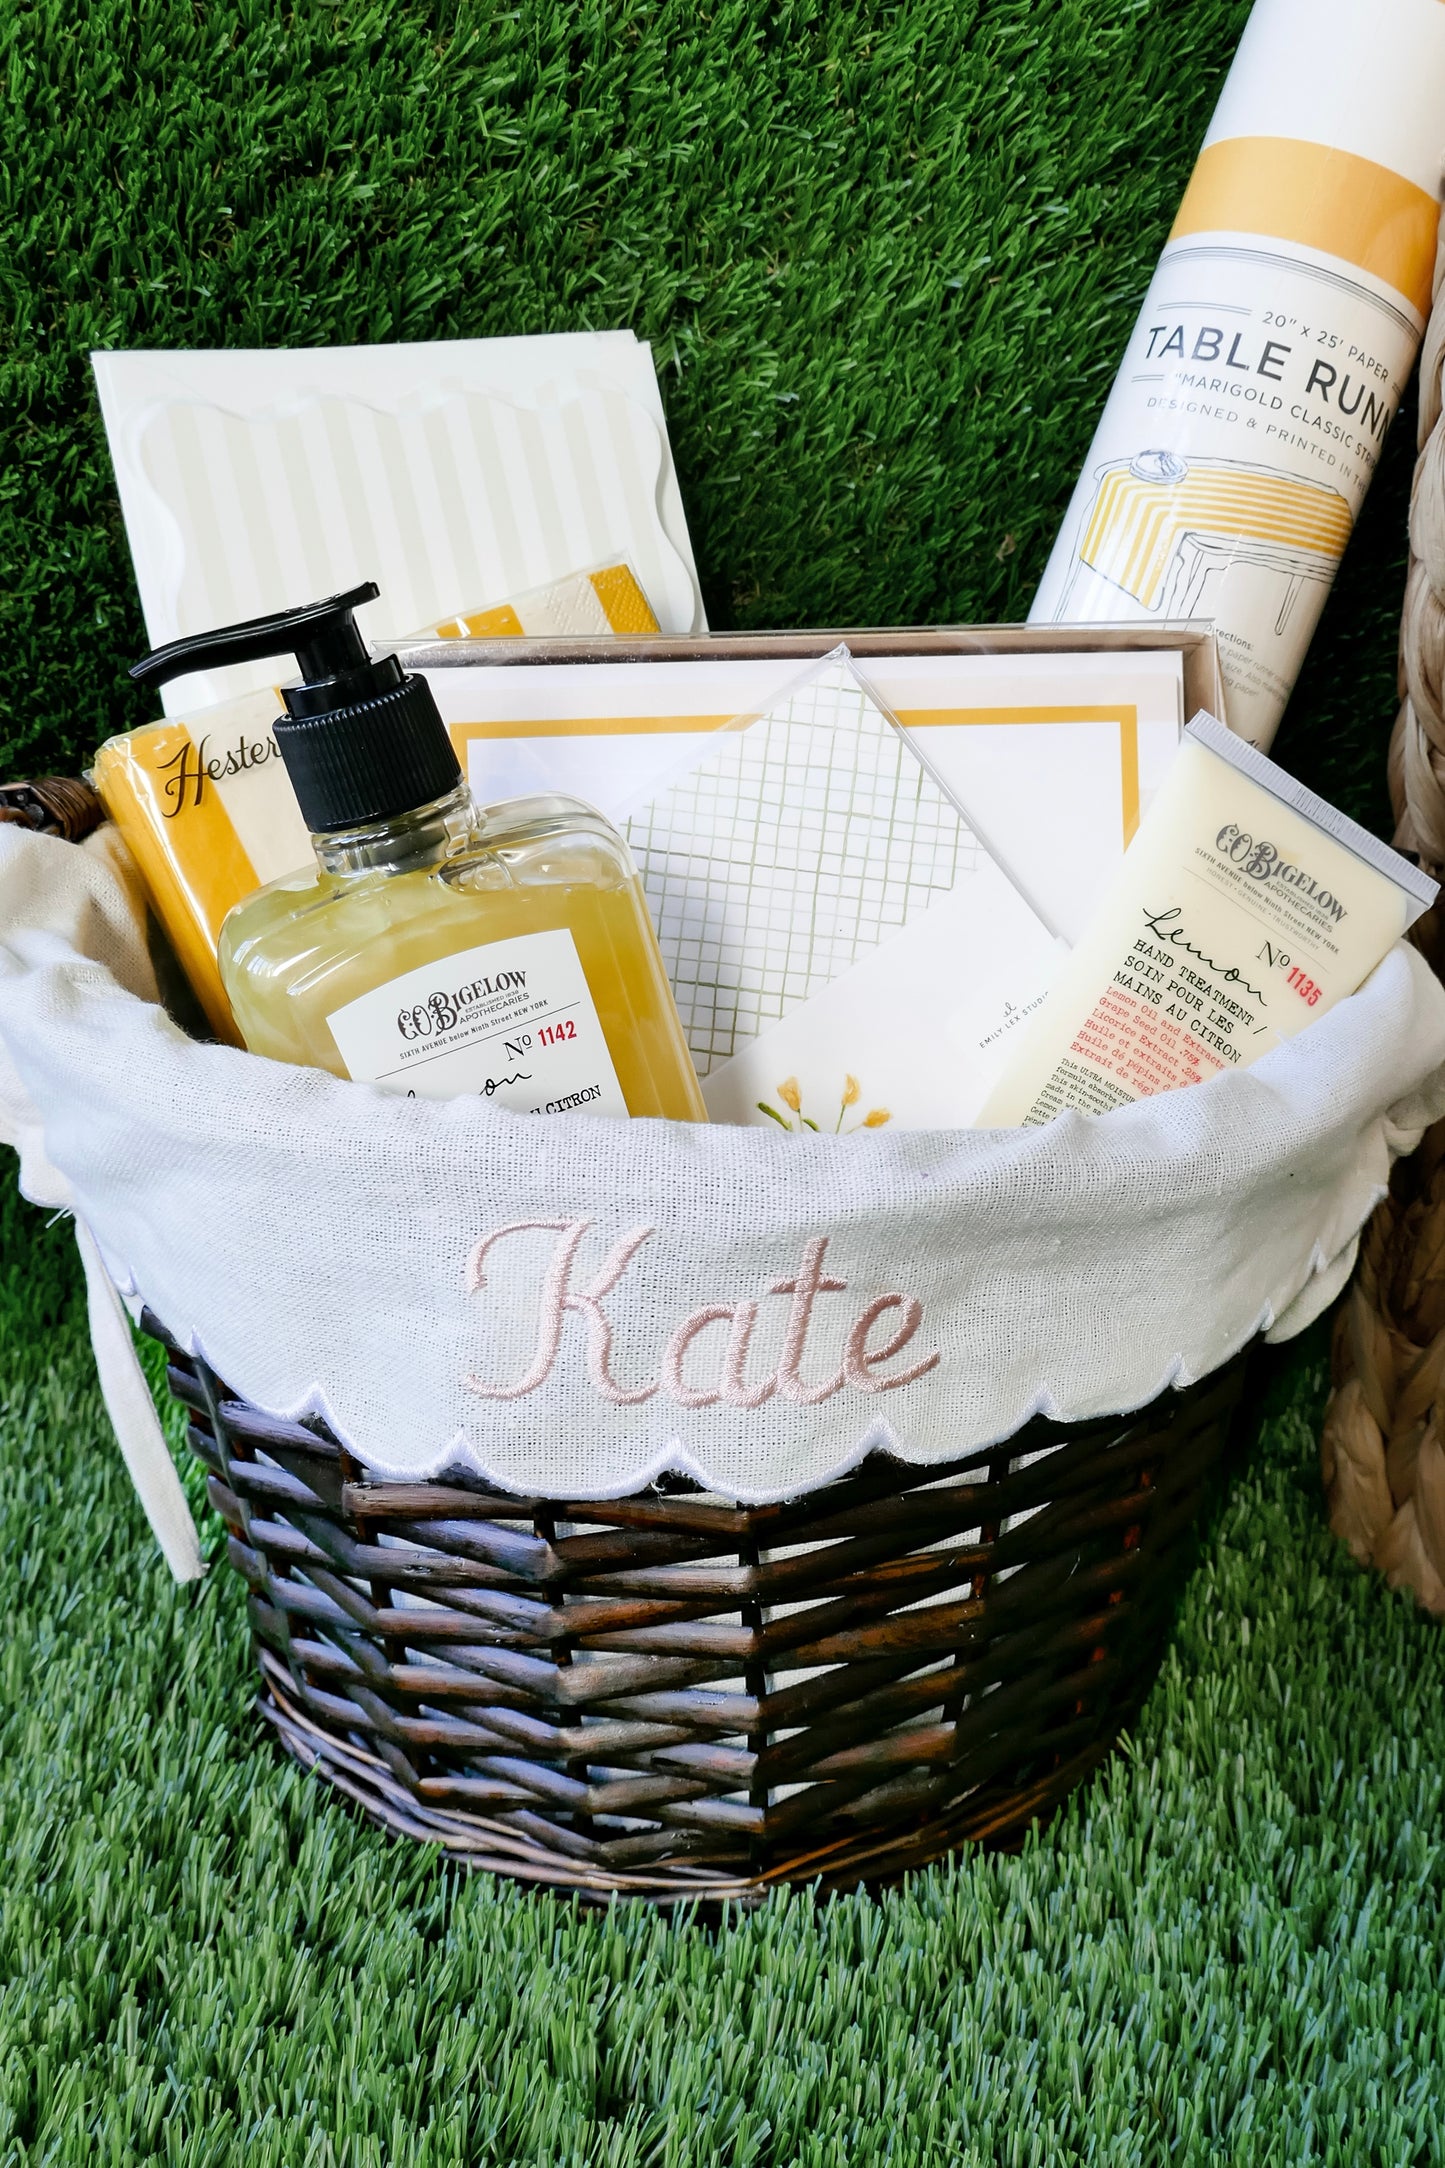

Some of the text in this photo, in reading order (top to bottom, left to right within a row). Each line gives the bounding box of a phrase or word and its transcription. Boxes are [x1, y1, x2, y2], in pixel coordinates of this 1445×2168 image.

[1146, 325, 1292, 381] TABLE
[1348, 345, 1389, 382] PAPER
[1147, 397, 1239, 422] DESIGNED
[1246, 418, 1258, 429] &
[1266, 424, 1337, 466] PRINTED
[1340, 463, 1351, 477] IN
[1290, 405, 1353, 448] CLASSIC
[157, 734, 281, 818] Hester
[1195, 848, 1340, 955] SIXTH AVENUE below Ninth Street NEW YORK
[1237, 889, 1266, 914] GENUINE
[1264, 881, 1333, 932] APOTHECARIES
[1142, 907, 1267, 1006] Lemon
[1124, 955, 1235, 1035] SOIN POUR LES
[1133, 939, 1175, 968] HAND
[1180, 965, 1255, 1027] TREATMENT
[1285, 966, 1323, 1007] 1135
[400, 1000, 548, 1060] SIXTH AVENUE below Ninth Street NEW YORK
[460, 993, 530, 1024] APOTHECARIES
[979, 1028, 1003, 1049] EMILY
[1005, 1015, 1021, 1028] LEX
[1099, 997, 1200, 1067] Grape Seed Oil .75%
[1105, 986, 1137, 1008] Lemon
[1141, 1005, 1158, 1021] Oil
[1161, 1019, 1181, 1037] and
[1113, 971, 1242, 1064] MAINS AU CITRON
[538, 1020, 577, 1047] 1142
[1084, 1019, 1116, 1041] Huile
[1118, 1038, 1131, 1049] et
[1133, 1048, 1178, 1082] extraits
[1092, 1008, 1137, 1038] Licorice
[1139, 1034, 1179, 1067] Extract
[1051, 1074, 1068, 1086] This
[1061, 1058, 1078, 1070] This
[1080, 1066, 1103, 1084] ULTRA
[1070, 1041, 1114, 1069] Extrait
[1115, 1066, 1129, 1079] de
[1076, 1030, 1109, 1051] Huile
[1126, 1058, 1160, 1086] pépins
[545, 1085, 602, 1115] CITRON
[1035, 1098, 1057, 1113] Lemon
[1040, 1090, 1063, 1104] Cream
[1045, 1083, 1064, 1095] made
[1066, 1091, 1076, 1101] in
[1078, 1098, 1091, 1109] the
[1056, 1066, 1117, 1104] formula absorbs
[1031, 1106, 1050, 1119] Cette
[466, 1217, 940, 1408] Kate
